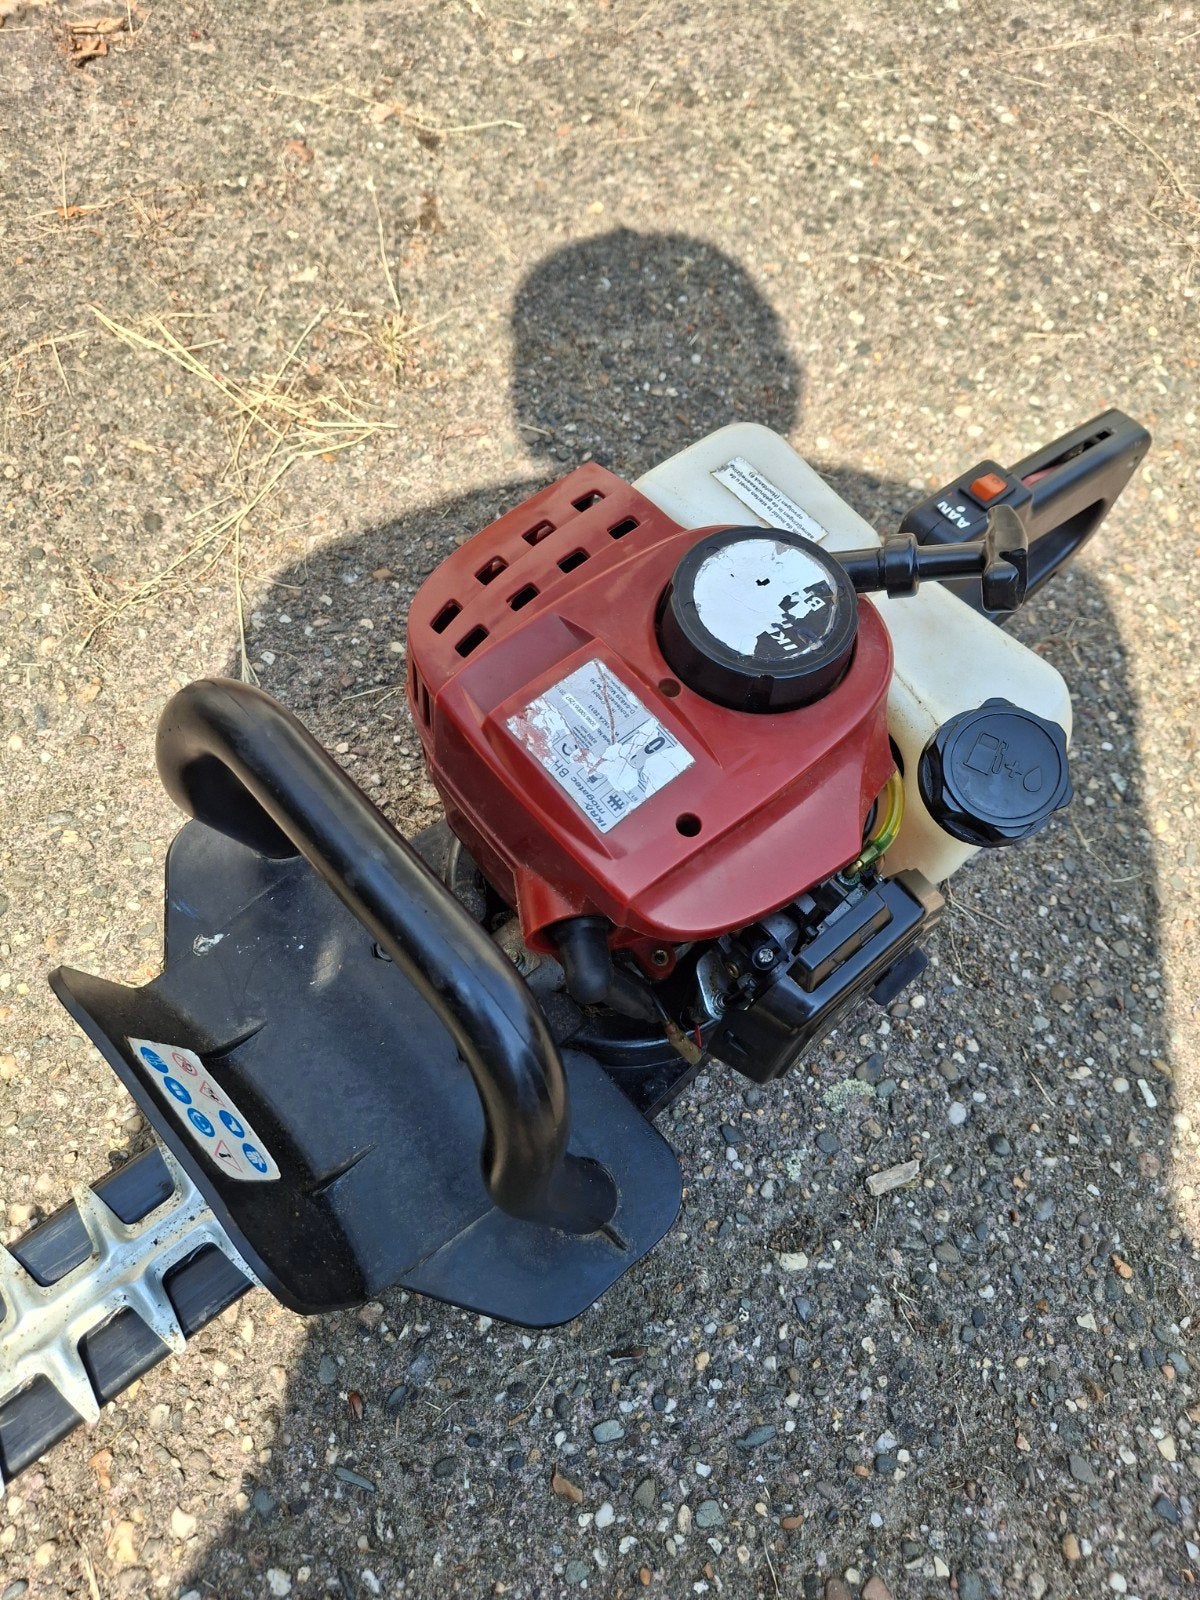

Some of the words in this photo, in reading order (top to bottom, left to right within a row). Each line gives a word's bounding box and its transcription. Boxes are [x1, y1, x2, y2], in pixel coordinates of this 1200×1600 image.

[937, 501, 970, 528] AAN
[570, 776, 605, 815] mogatec
[585, 802, 607, 827] IKRA
